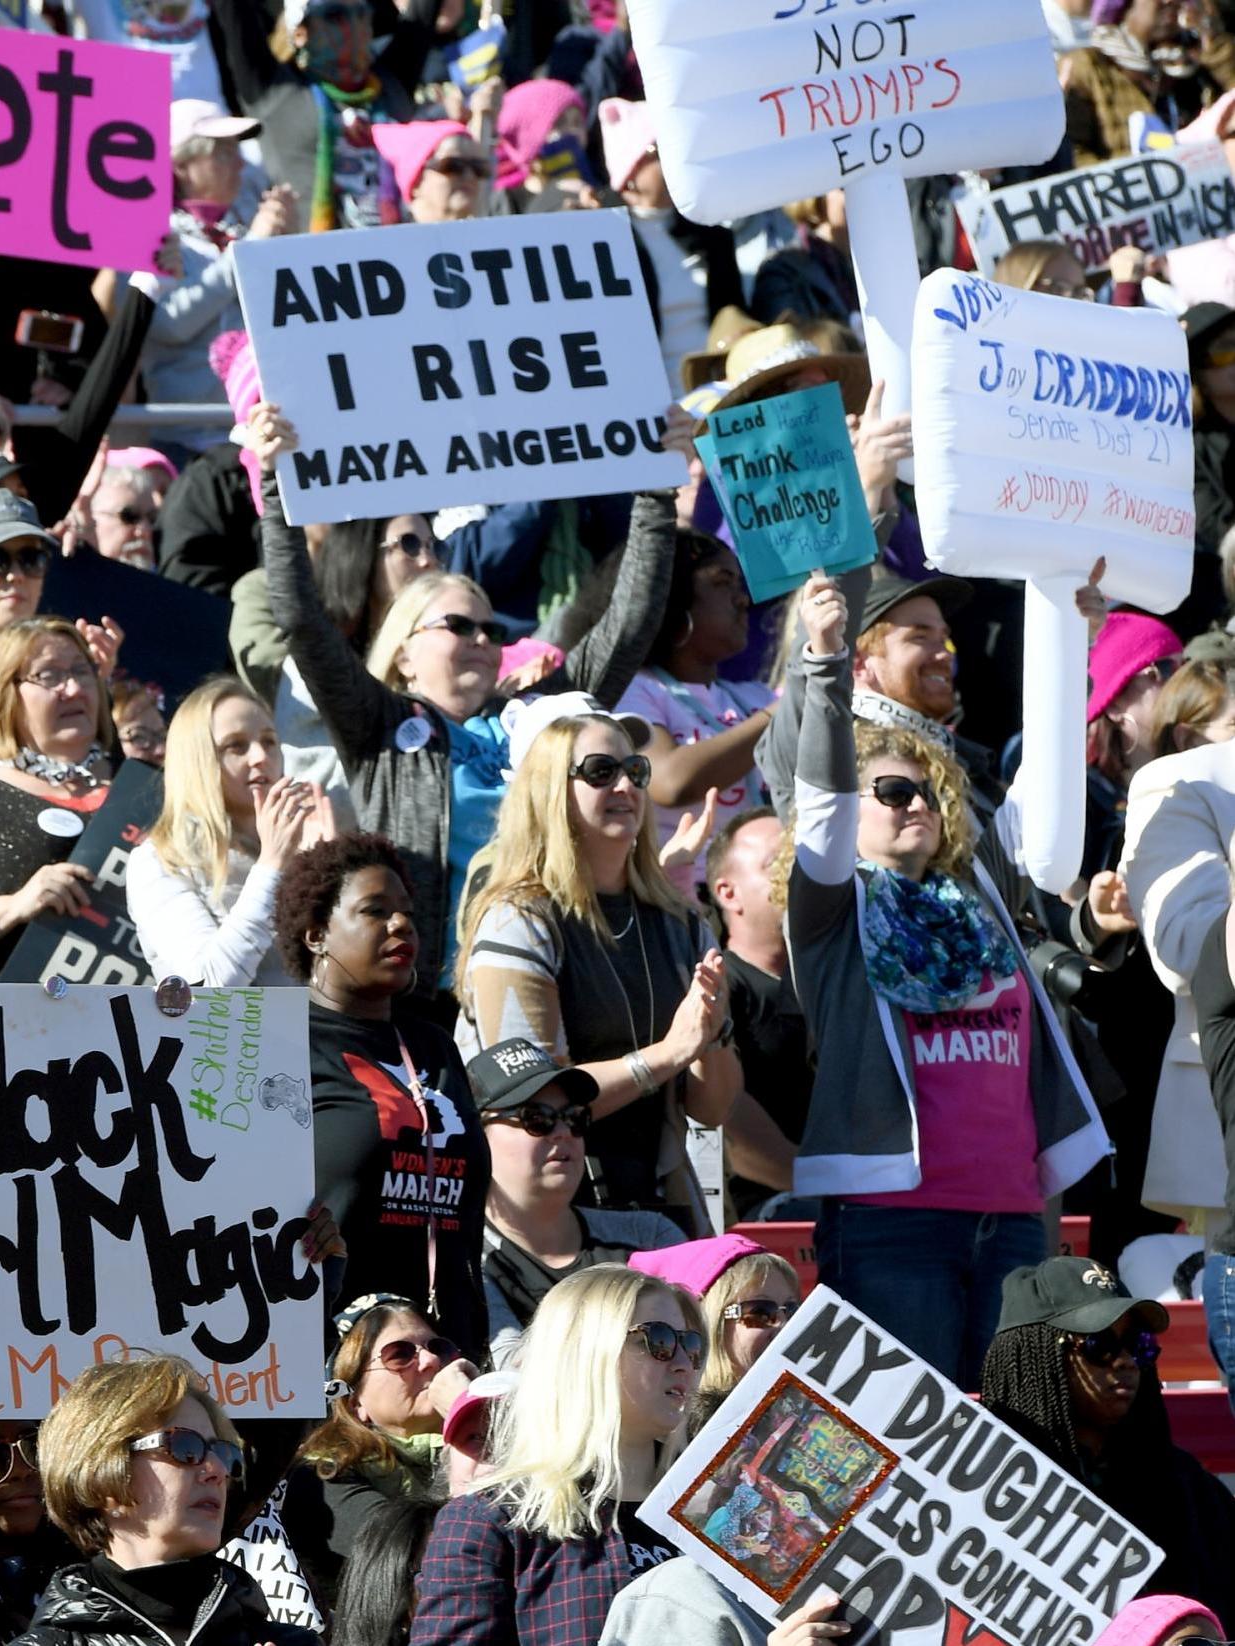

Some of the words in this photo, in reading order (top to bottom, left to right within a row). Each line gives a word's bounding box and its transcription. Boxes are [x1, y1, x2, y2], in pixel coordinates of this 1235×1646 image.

[814, 14, 915, 74] NOT
[760, 58, 960, 136] TRUMP'S
[831, 122, 925, 176] EGO
[993, 159, 1186, 244] HATRED
[272, 259, 406, 328] AND
[427, 241, 632, 310] STILL
[327, 352, 356, 410] I
[412, 331, 608, 402] RISE
[1033, 348, 1191, 429] CRADDOCK
[293, 438, 428, 490] MAYA
[447, 416, 669, 474] ANGELOU
[715, 404, 766, 438] Lead
[1008, 404, 1080, 443] Senate
[719, 444, 799, 481] Think
[733, 484, 841, 530] Challenge
[913, 1029, 1020, 1067] MARCH
[51, 1161, 321, 1364] Magic
[782, 1302, 915, 1406] MY
[883, 1370, 1151, 1619] DAUGHTER
[867, 1471, 953, 1557] IS
[936, 1527, 1094, 1646] COMING
